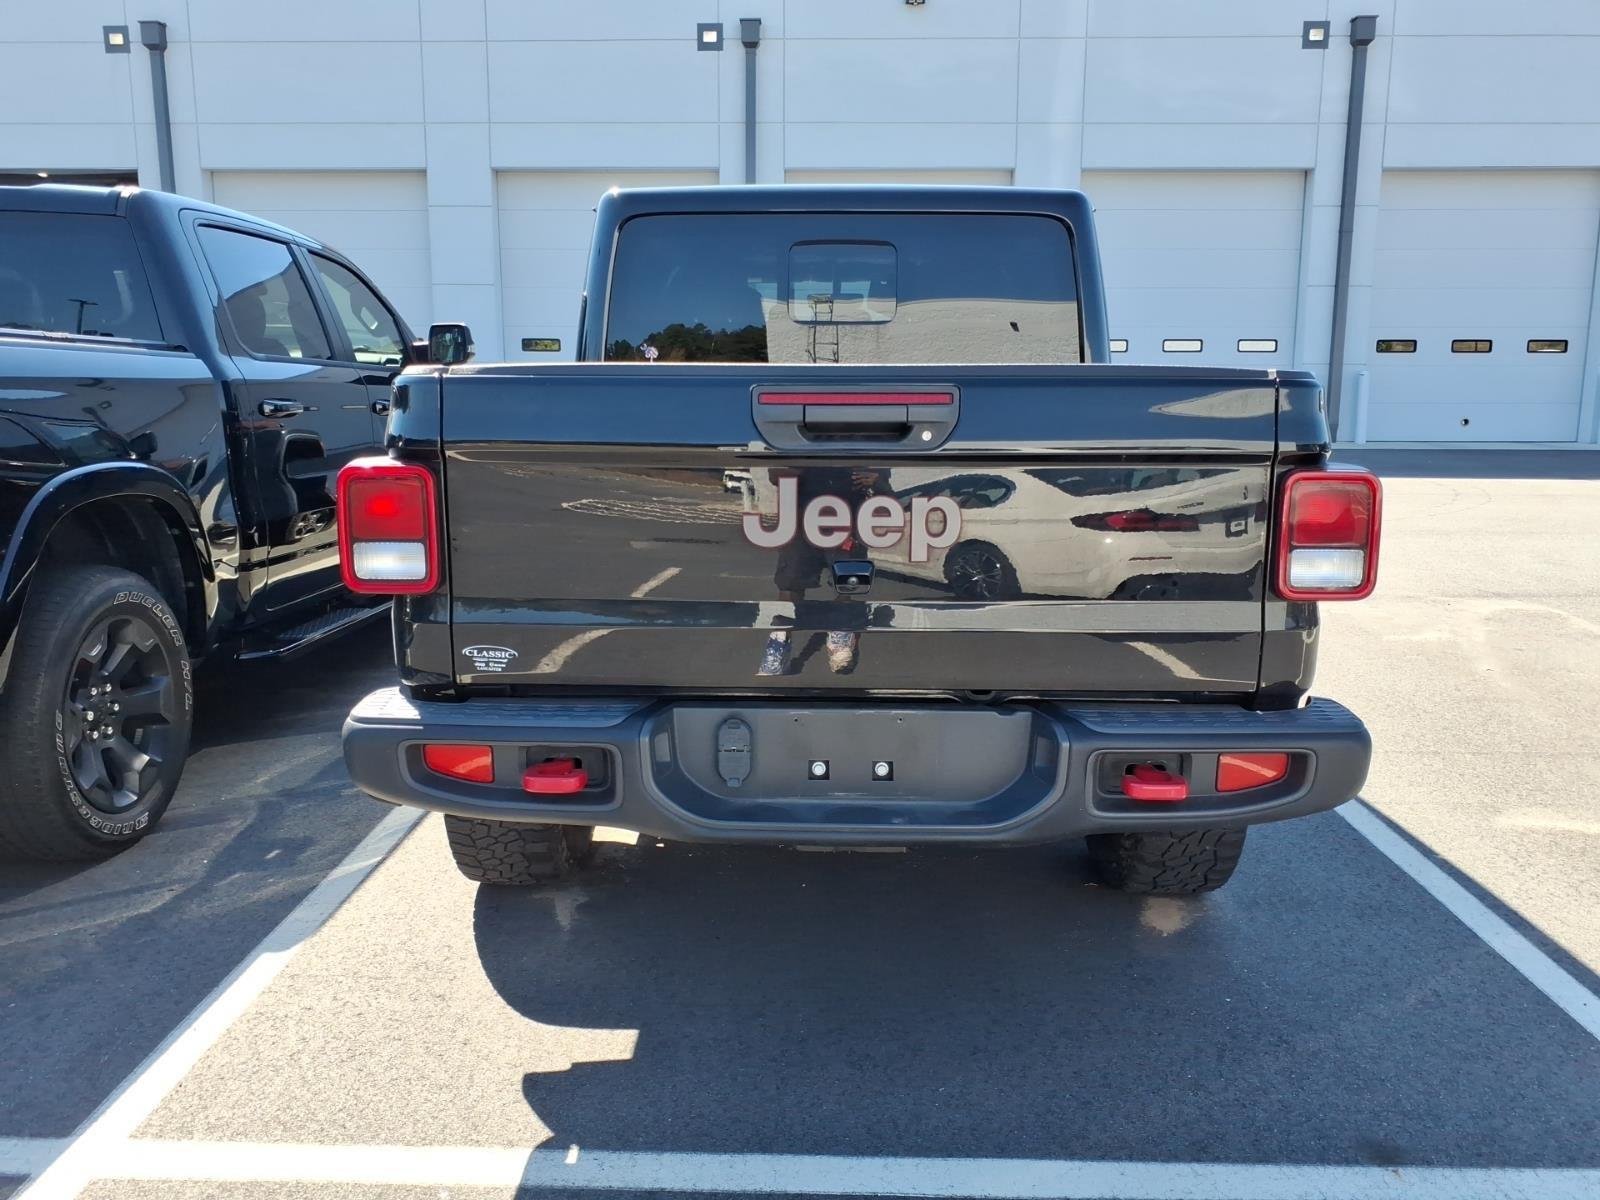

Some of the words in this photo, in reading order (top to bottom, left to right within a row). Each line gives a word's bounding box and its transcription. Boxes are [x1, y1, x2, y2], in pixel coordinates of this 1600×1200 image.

[742, 476, 962, 563] Jeep
[113, 591, 183, 647] DUELER
[465, 649, 514, 659] CLASSIC
